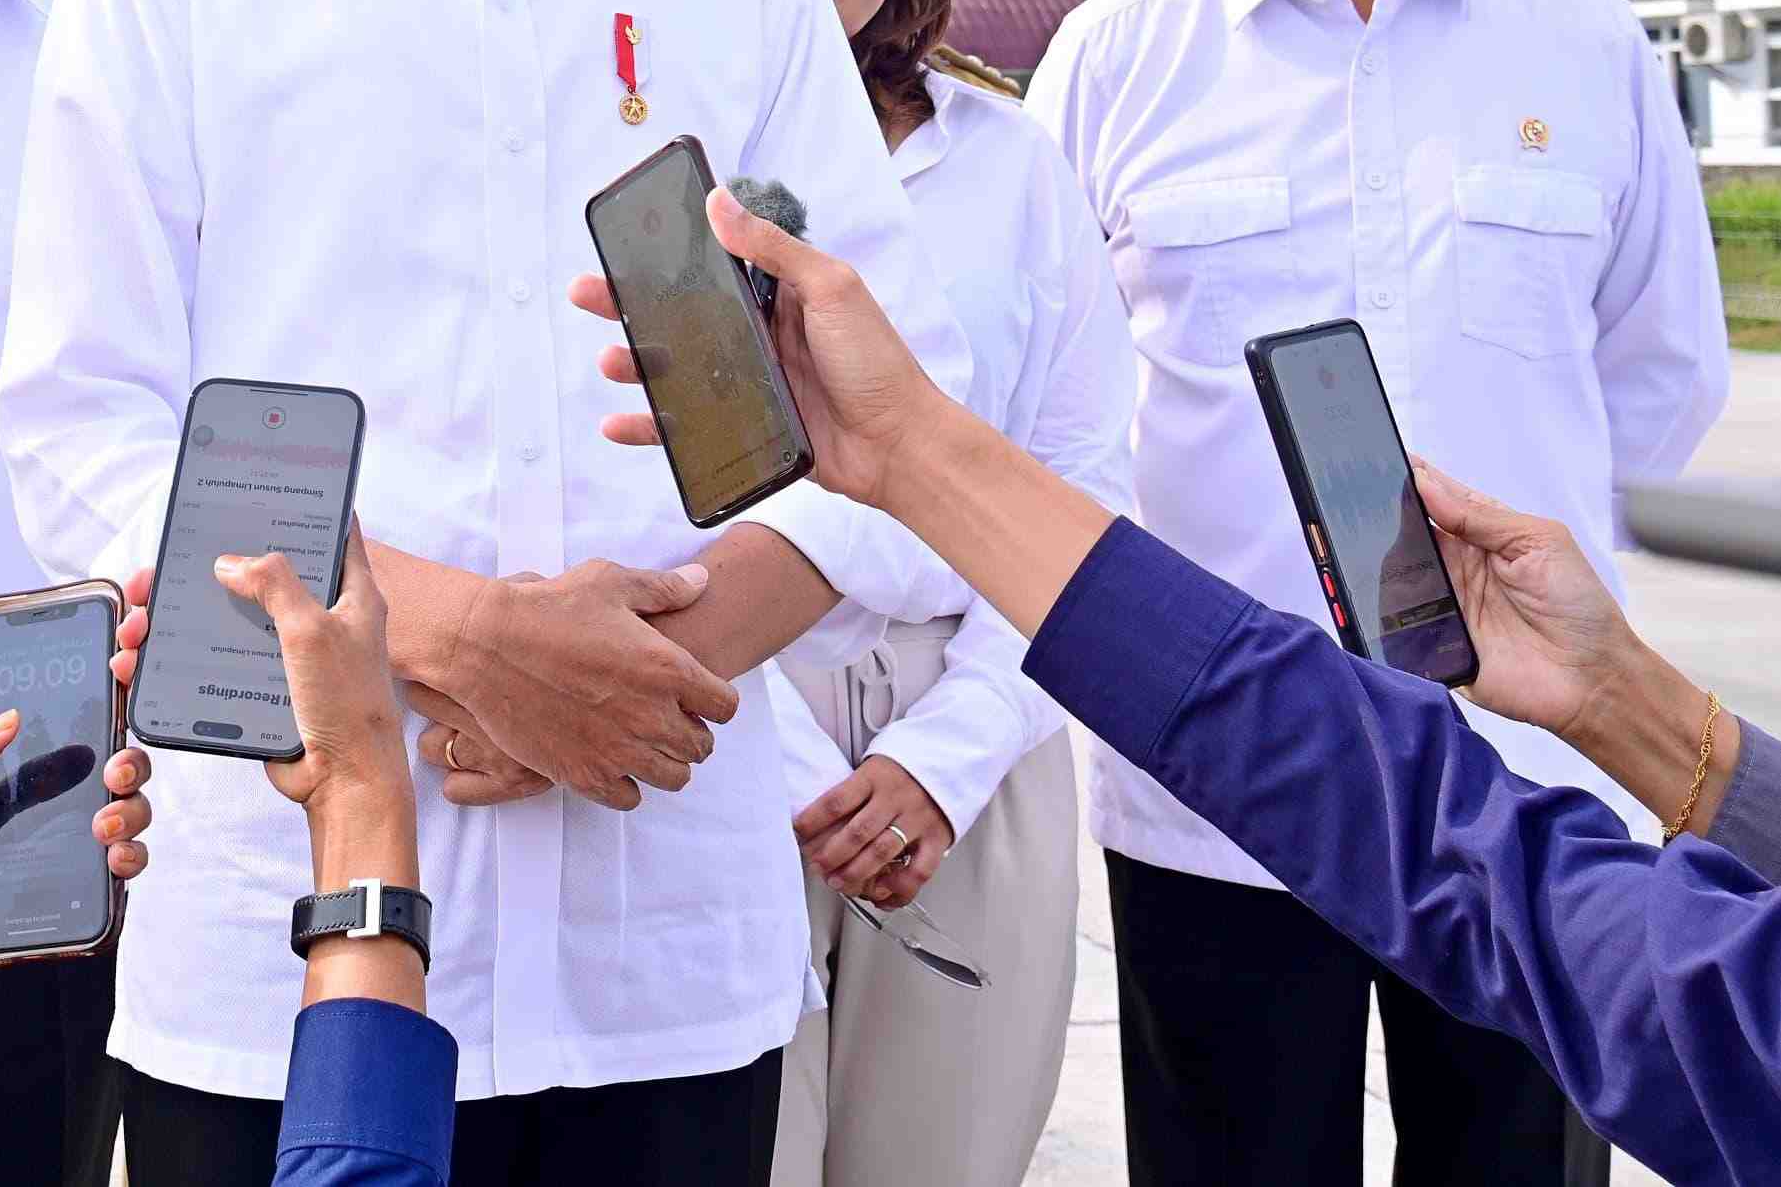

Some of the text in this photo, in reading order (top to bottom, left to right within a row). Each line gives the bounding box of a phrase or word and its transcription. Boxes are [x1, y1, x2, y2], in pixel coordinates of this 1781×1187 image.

[204, 477, 253, 493] Limapuluh
[253, 483, 283, 495] Susun
[283, 485, 324, 499] Simpang
[197, 683, 281, 707] Recordings
